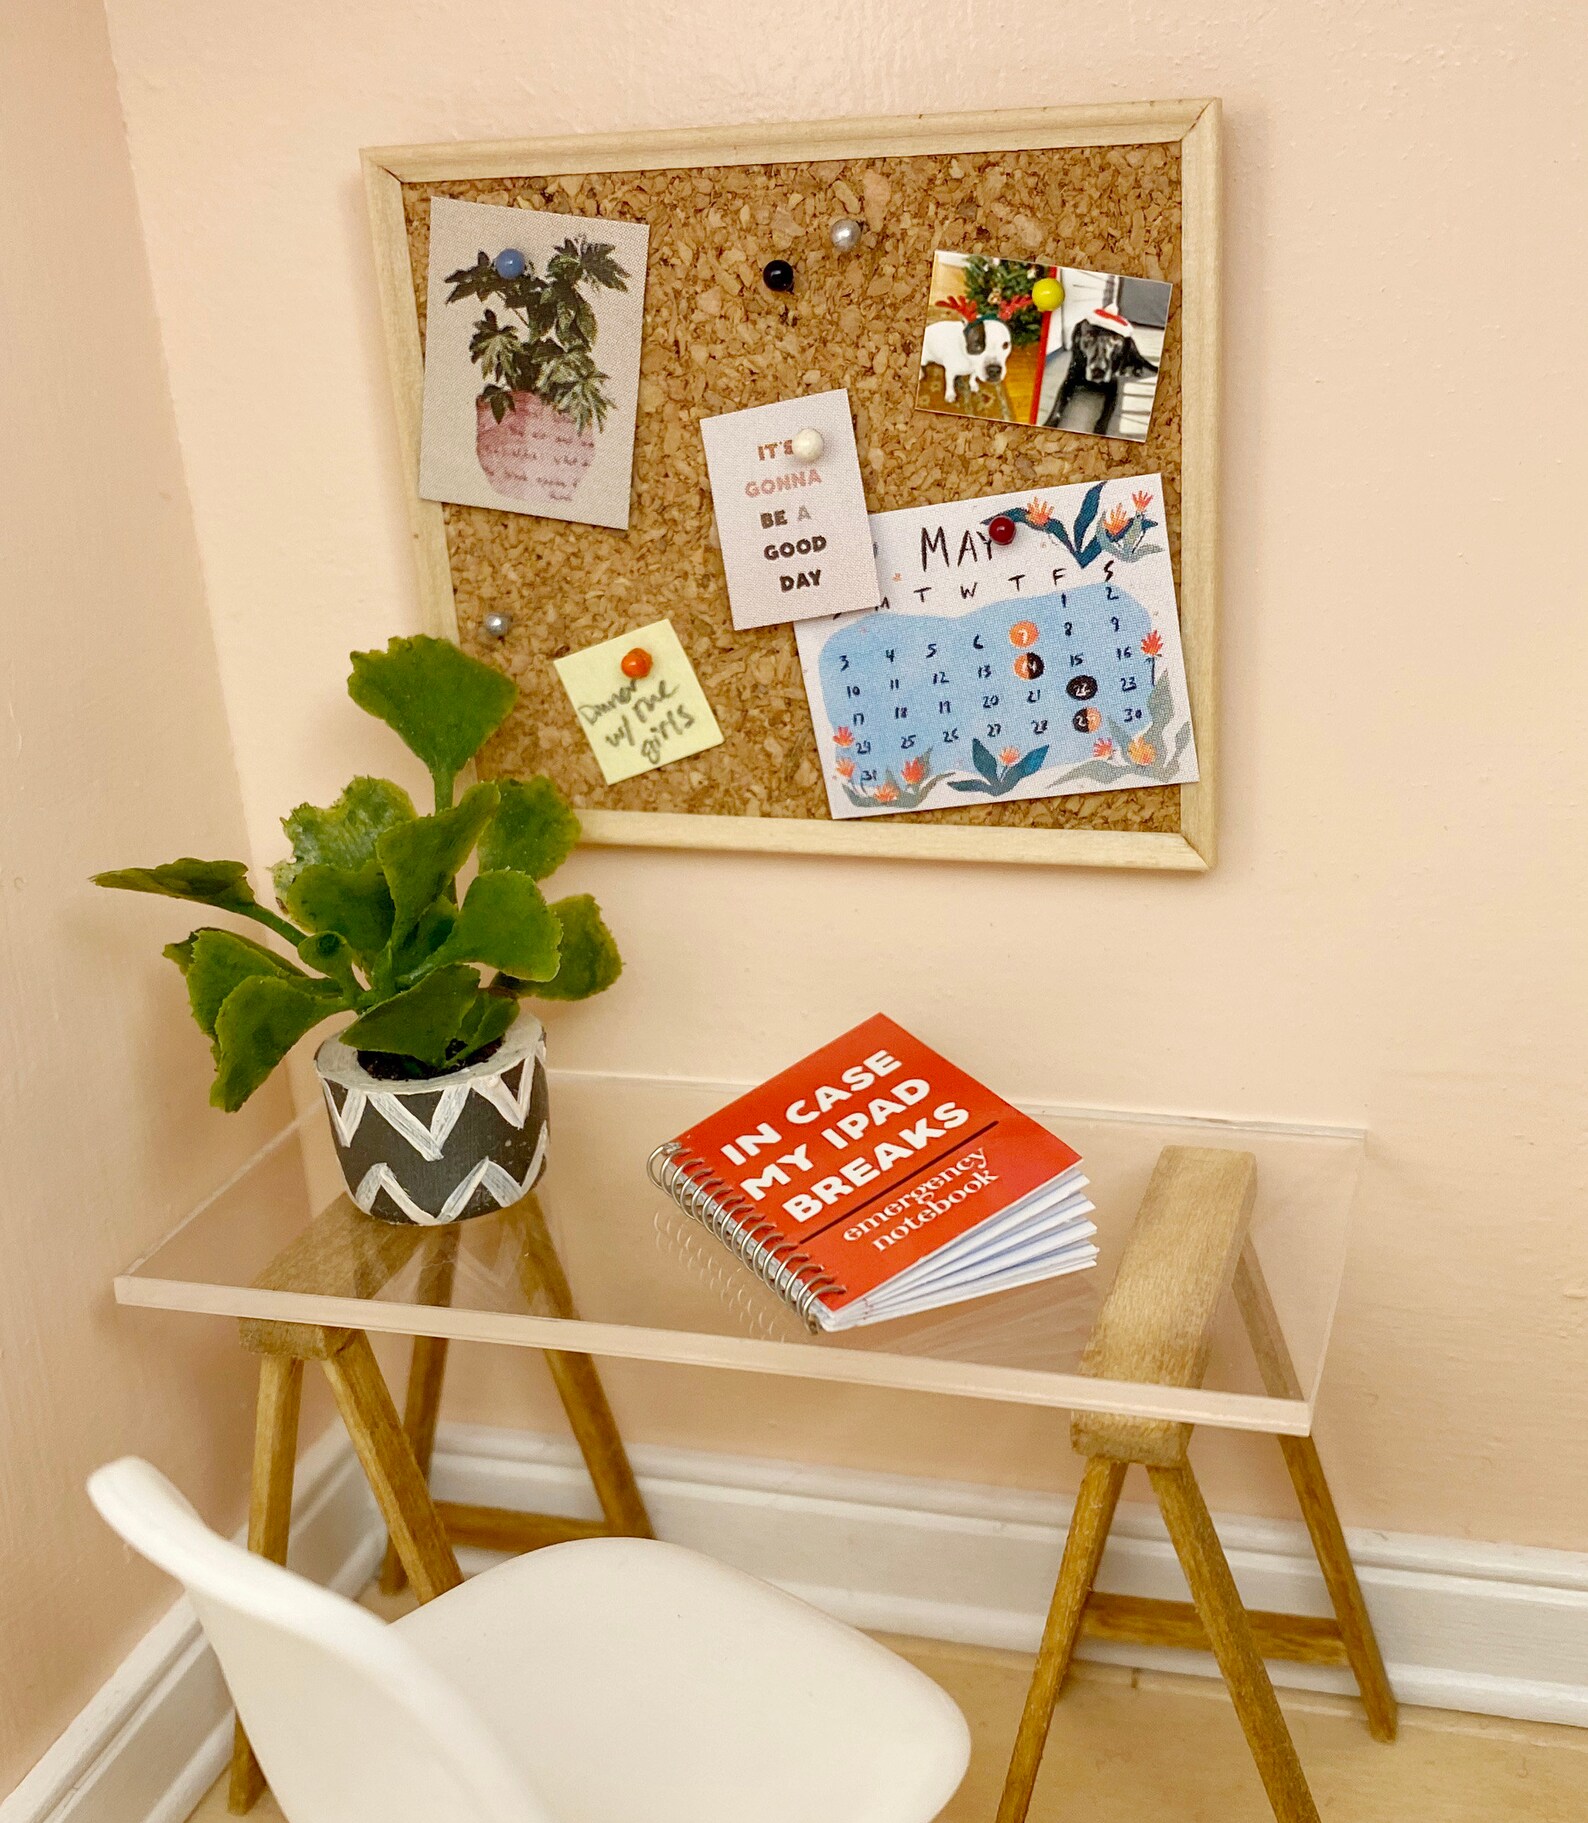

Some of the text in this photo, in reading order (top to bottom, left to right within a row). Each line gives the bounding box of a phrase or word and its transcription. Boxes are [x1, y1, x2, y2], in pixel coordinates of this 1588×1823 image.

[745, 469, 822, 498] GONNA
[760, 505, 812, 529] BE A
[763, 535, 827, 561] GOOD
[921, 526, 993, 572] MAY
[779, 569, 822, 593] DAY
[914, 587, 932, 602] T
[960, 582, 978, 599] W
[1008, 574, 1026, 591] T
[1052, 568, 1067, 586] F
[1104, 560, 1115, 582] S
[1104, 587, 1119, 600] 2
[839, 655, 850, 671] 3
[885, 649, 895, 662] 4
[926, 643, 938, 658] 5
[972, 634, 984, 649] 6
[1063, 621, 1073, 636] 8
[1110, 616, 1120, 632] 9
[846, 686, 861, 699] 10
[890, 679, 900, 690] 11
[932, 671, 950, 685] 12
[977, 664, 992, 679] 13
[1070, 652, 1084, 667] 15
[1116, 646, 1132, 660] 16
[853, 713, 865, 726] 17
[895, 706, 908, 719] 18
[939, 700, 951, 714] 19
[982, 695, 1000, 709] 20
[1027, 689, 1041, 703] 21
[1120, 676, 1138, 692] 23
[604, 714, 635, 747] w/
[640, 703, 695, 765] girls
[856, 739, 871, 754] 24
[900, 734, 916, 749] 25
[942, 728, 960, 743] 26
[987, 723, 1001, 737] 27
[1031, 720, 1048, 734] 28
[1124, 708, 1143, 723] 30
[862, 770, 877, 781] 31
[720, 1049, 902, 1166] IN CASE
[739, 1078, 931, 1202] MY IPAD
[781, 1101, 970, 1222] BREAKS
[842, 1146, 988, 1243] emergency
[871, 1167, 1000, 1253] notebook
